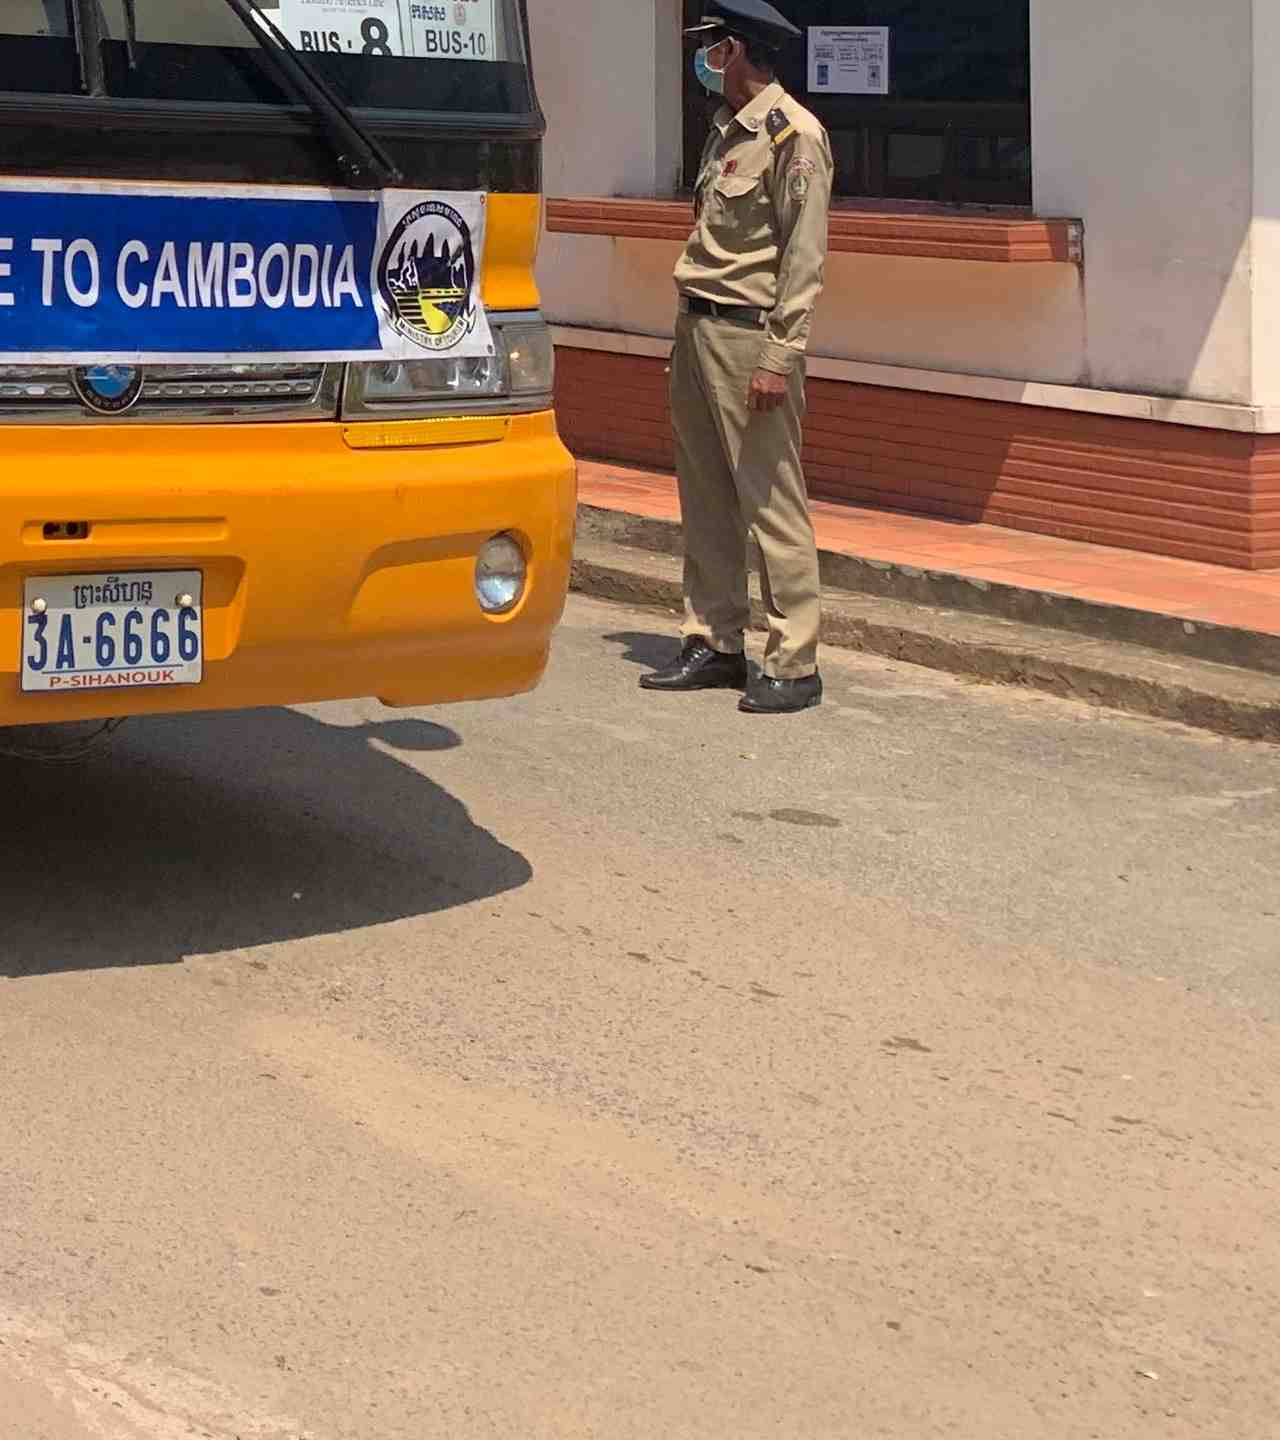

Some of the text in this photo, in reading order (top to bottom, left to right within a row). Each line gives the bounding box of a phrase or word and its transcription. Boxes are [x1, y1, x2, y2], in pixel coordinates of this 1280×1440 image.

[300, 30, 342, 53] BUS
[360, 17, 393, 56] 8
[425, 29, 486, 55] BUS-10
[30, 237, 100, 308] TO
[116, 239, 364, 309] CAMBODIA
[27, 607, 199, 672] 3A-6666
[48, 669, 175, 688] P-SIHANOUK
